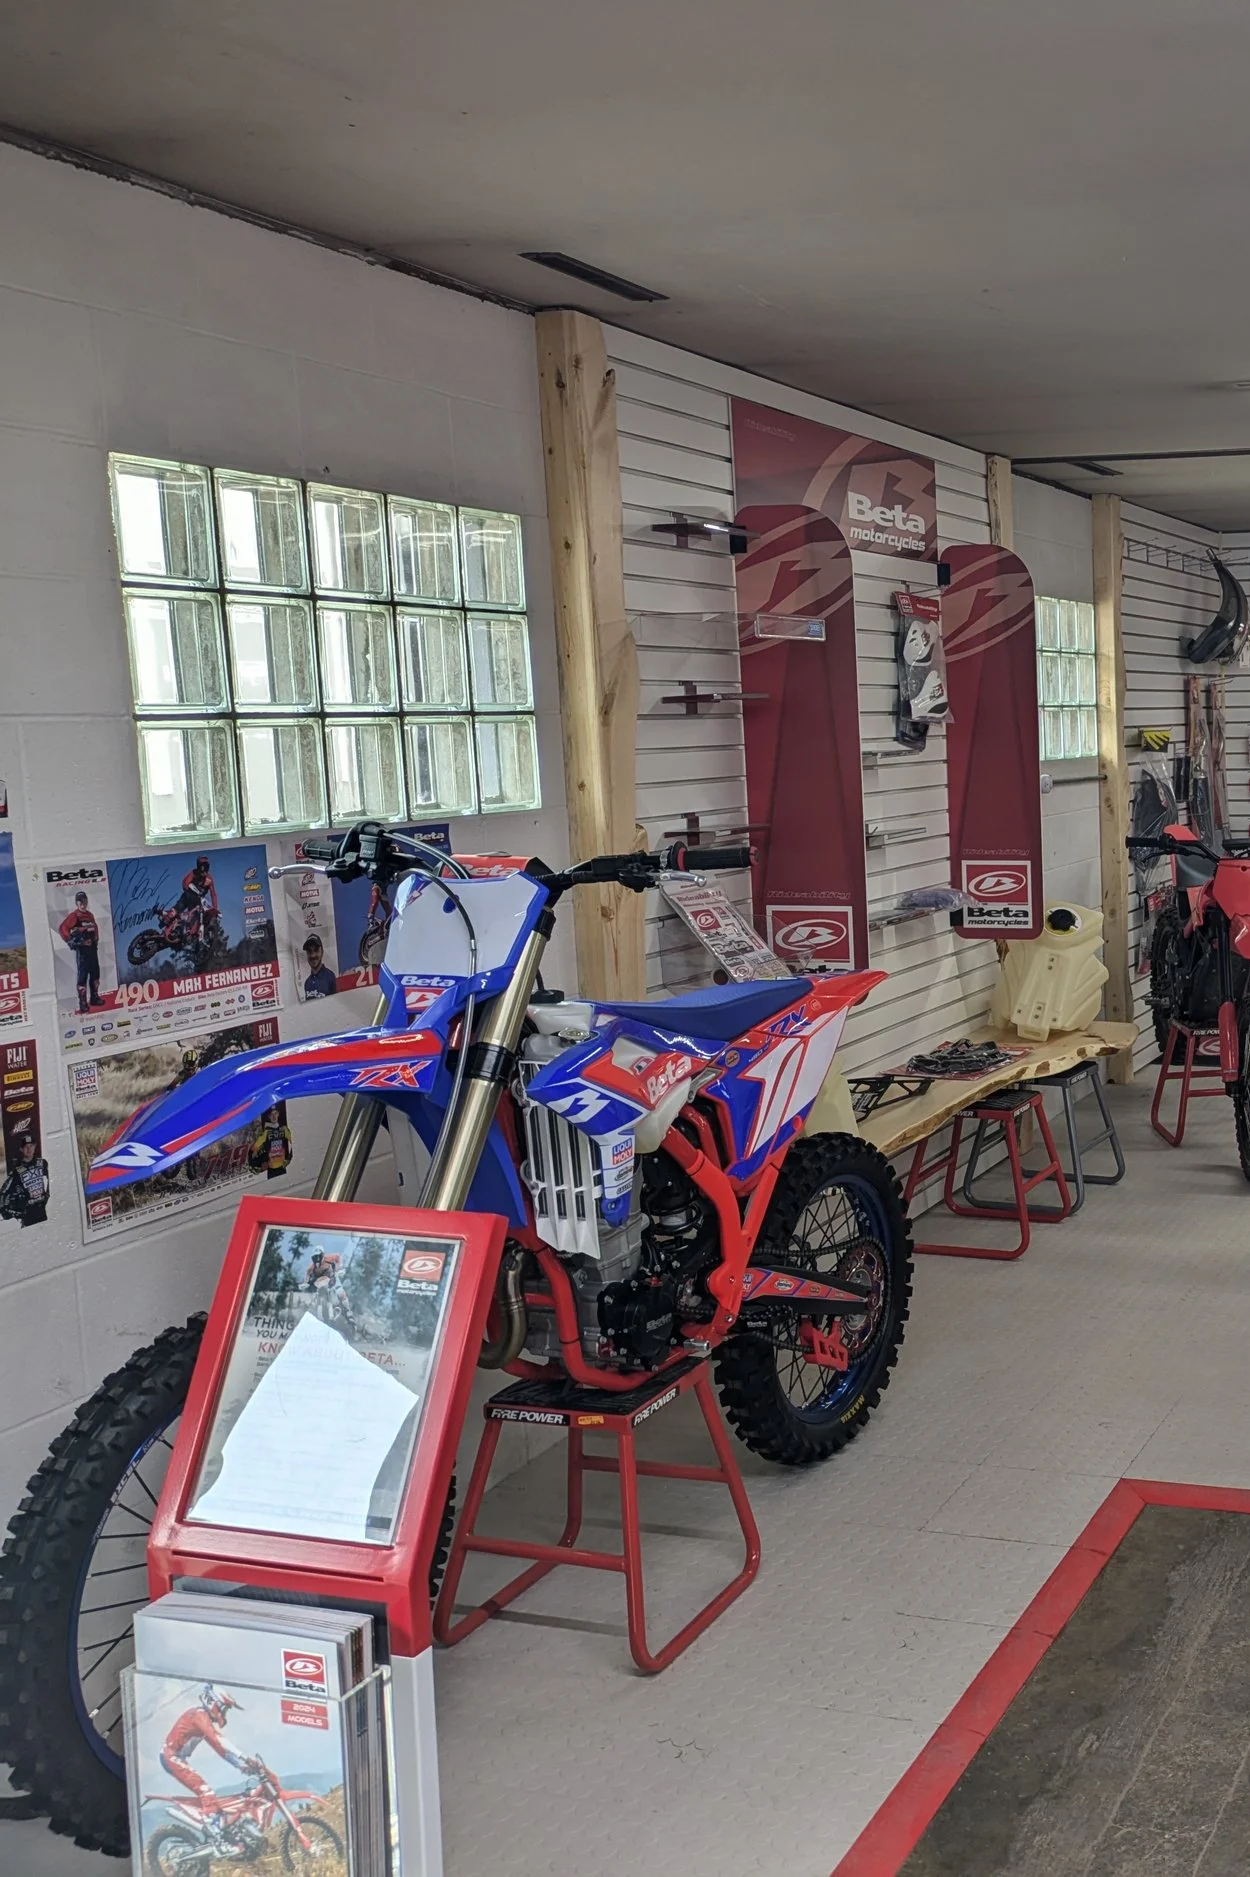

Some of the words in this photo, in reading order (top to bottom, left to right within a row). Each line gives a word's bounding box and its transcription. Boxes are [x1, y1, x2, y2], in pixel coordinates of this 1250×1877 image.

[848, 491, 926, 535] Beta
[850, 526, 926, 551] motorcycles
[414, 832, 445, 841] Beta
[46, 868, 103, 882] Beta
[246, 906, 265, 914] MOTUL
[967, 906, 1029, 918] Beta
[968, 918, 1029, 927] motorcycles
[355, 966, 375, 987] 21
[401, 975, 456, 987] Beta
[115, 979, 160, 1007] 490
[205, 965, 273, 989] FERNANDEZ
[252, 1000, 277, 1008] Beta
[259, 1022, 272, 1038] FIJI
[7, 1046, 28, 1064] FIJI
[646, 1055, 691, 1103] Beta
[4, 1086, 34, 1097] Beta
[613, 1139, 632, 1155] LIQUI
[613, 1149, 632, 1165] MOLY
[396, 1279, 439, 1291] Beta
[396, 1289, 437, 1297] motorcycles
[254, 1316, 297, 1331] THING
[256, 1329, 276, 1340] YOU
[633, 1404, 652, 1427] FIRE
[650, 1387, 677, 1415] POWER
[491, 1408, 518, 1420] FIRE
[518, 1410, 564, 1424] POWER
[285, 1679, 326, 1693] Beta
[292, 1703, 316, 1714] 2024
[287, 1714, 323, 1727] MODELS
